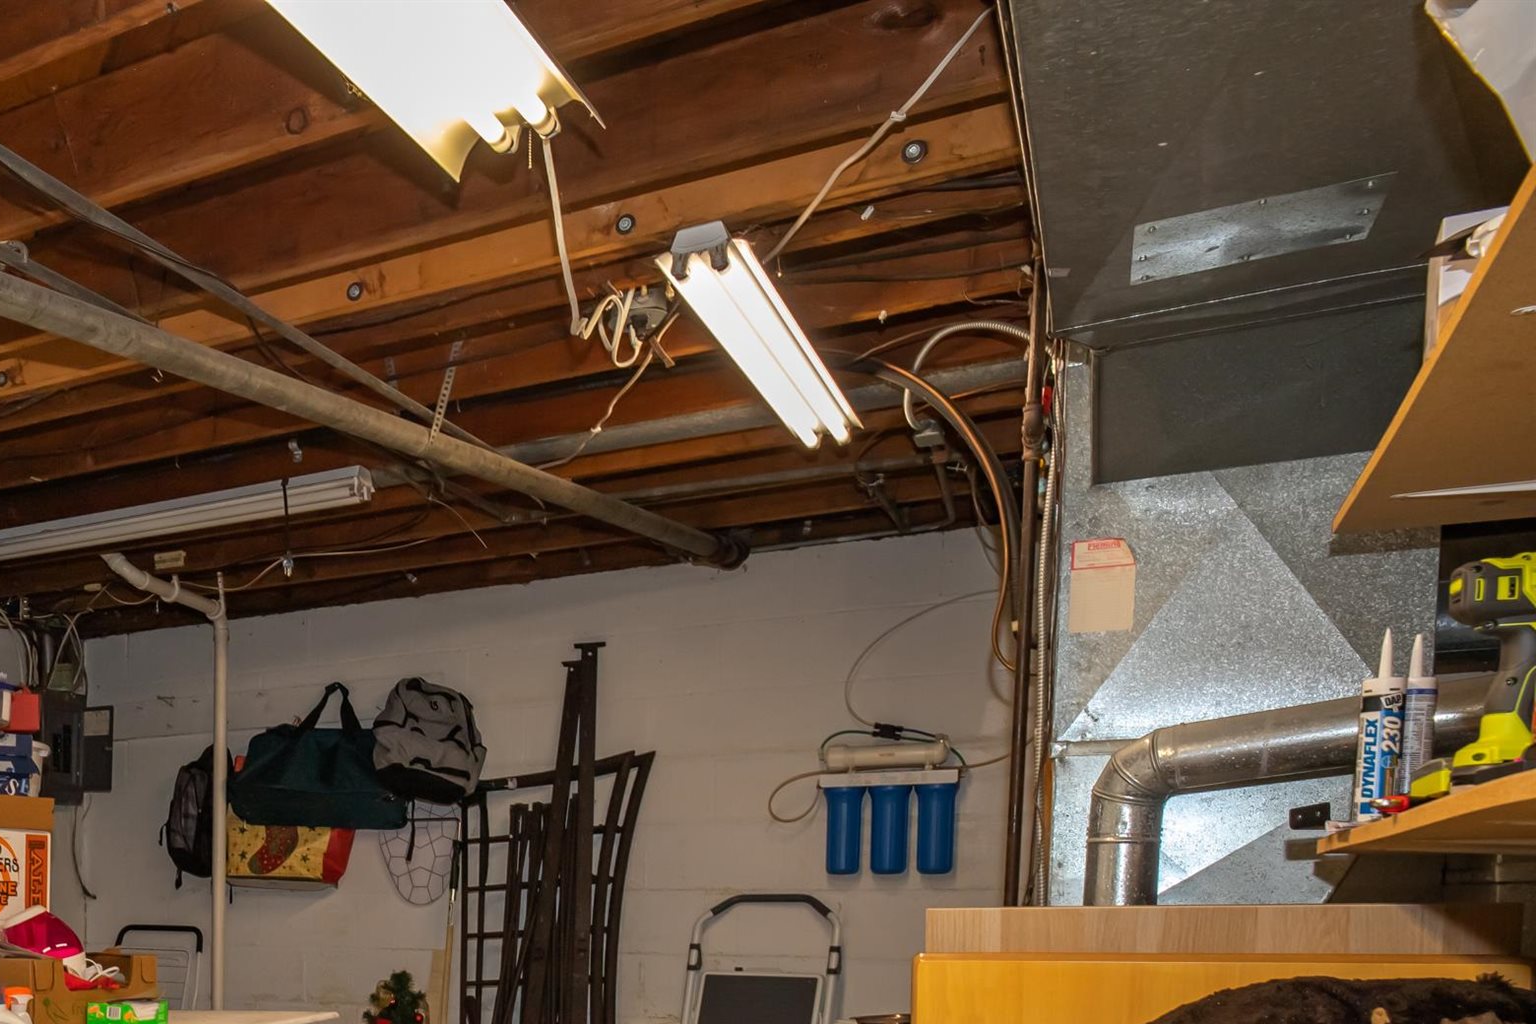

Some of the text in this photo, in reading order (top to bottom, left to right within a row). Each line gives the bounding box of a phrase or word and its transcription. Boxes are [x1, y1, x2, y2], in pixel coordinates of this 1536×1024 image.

[1385, 695, 1402, 706] DAP
[1381, 716, 1402, 754] 230
[1361, 718, 1378, 798] DYNAFLEX
